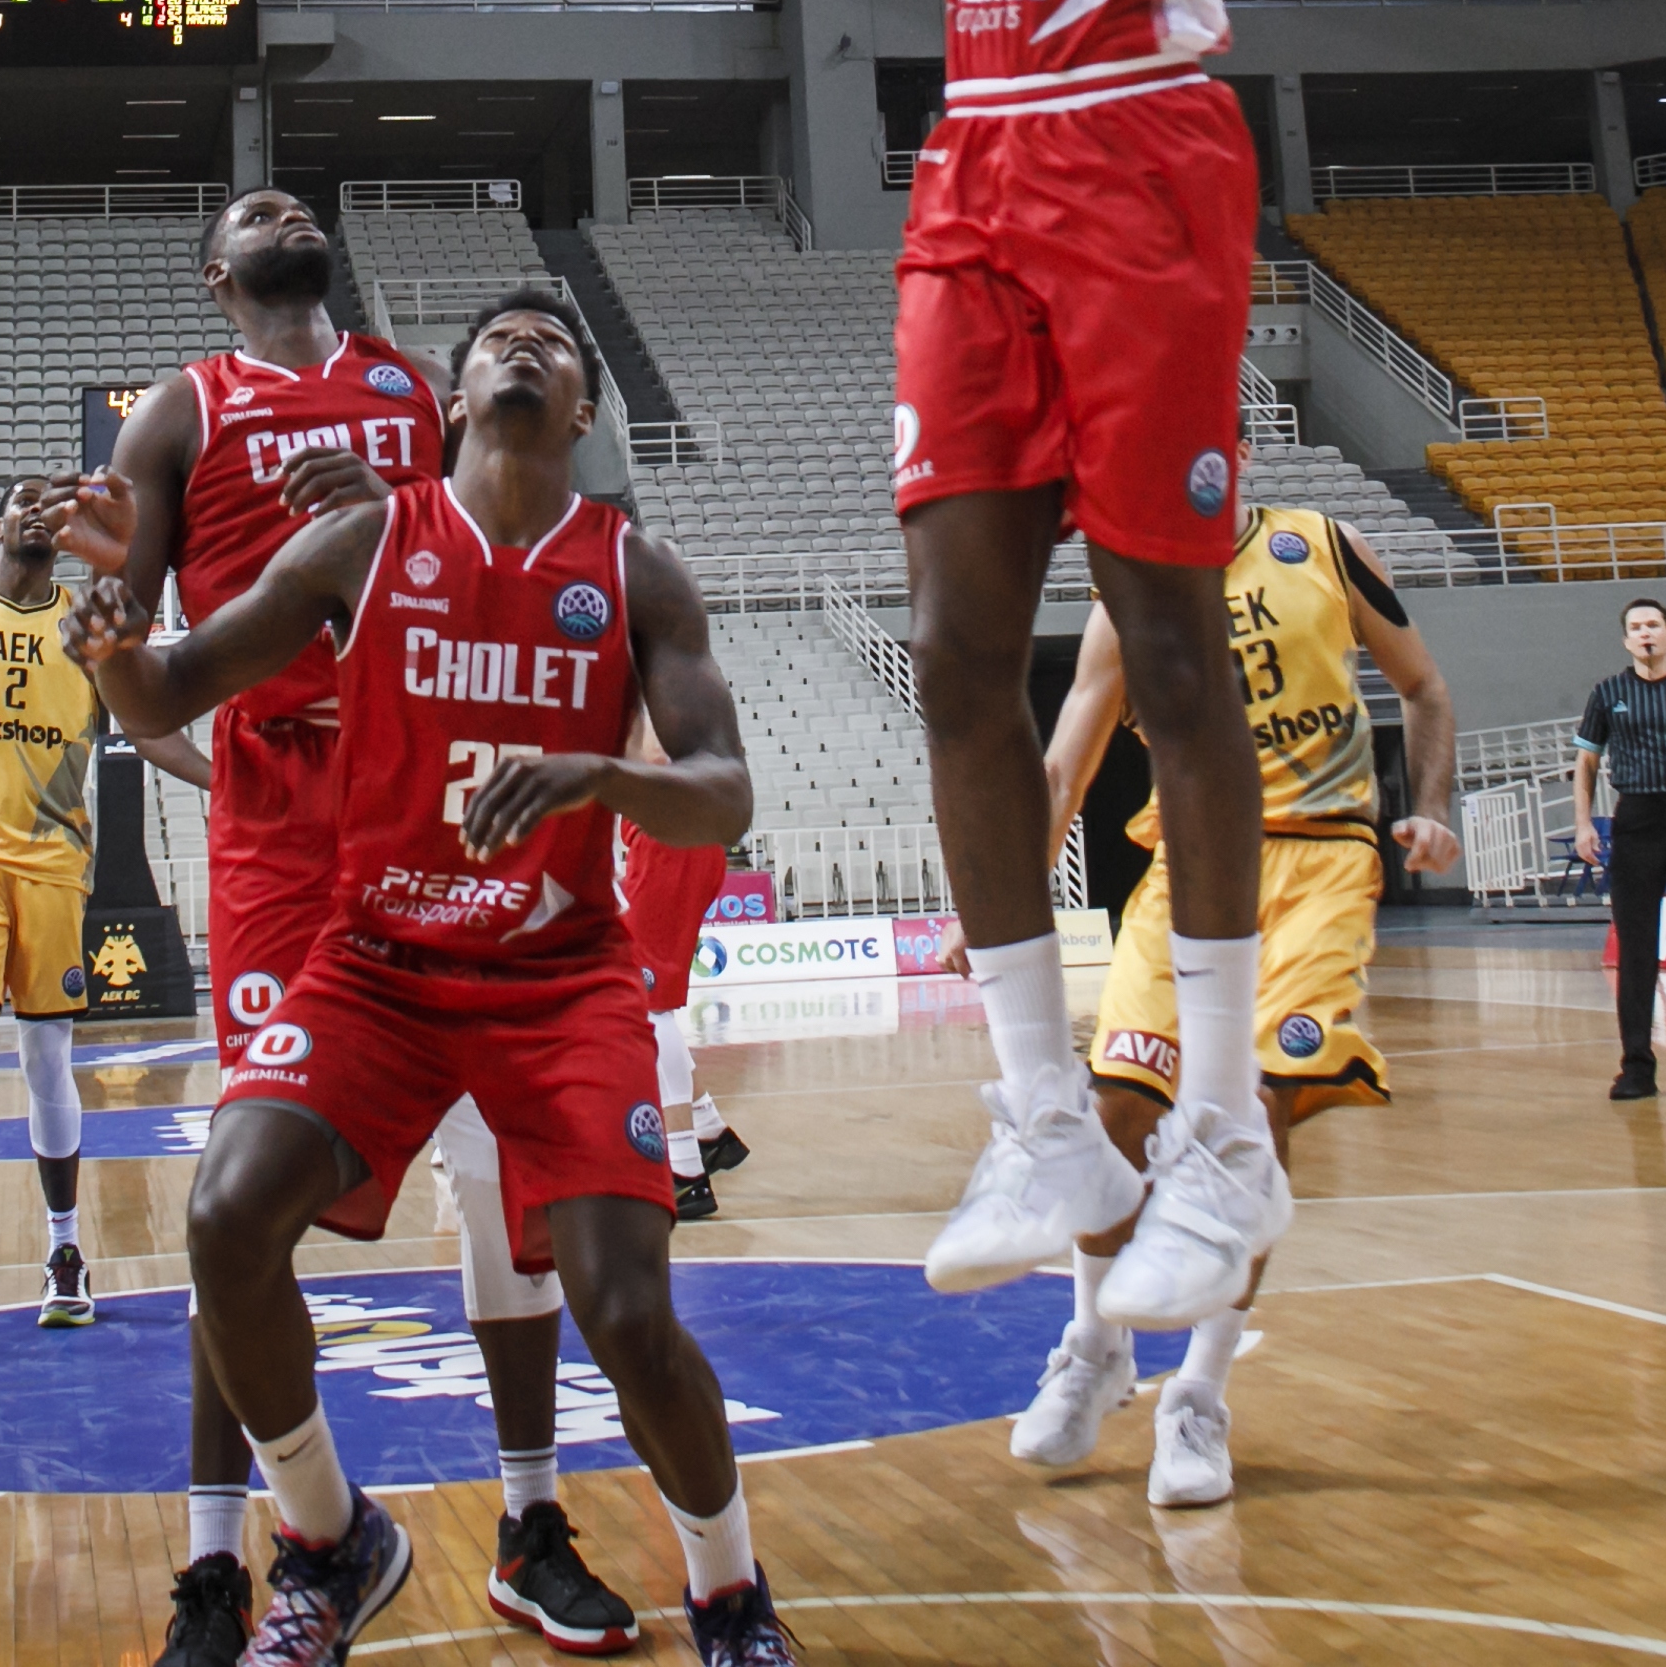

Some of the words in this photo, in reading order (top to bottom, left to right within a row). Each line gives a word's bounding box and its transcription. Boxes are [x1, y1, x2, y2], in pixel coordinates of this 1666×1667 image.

[121, 12, 132, 27] 4
[157, 14, 165, 25] 2
[162, 5, 165, 14] 1
[390, 592, 450, 614] SPALDING
[1224, 586, 1280, 639] EK
[5, 667, 28, 710] 2
[361, 883, 494, 928] Transports
[737, 936, 879, 966] COSMOTE
[124, 989, 141, 1001] BC
[242, 985, 270, 1014] U
[262, 1034, 296, 1055] U
[1106, 1032, 1177, 1077] AVIS
